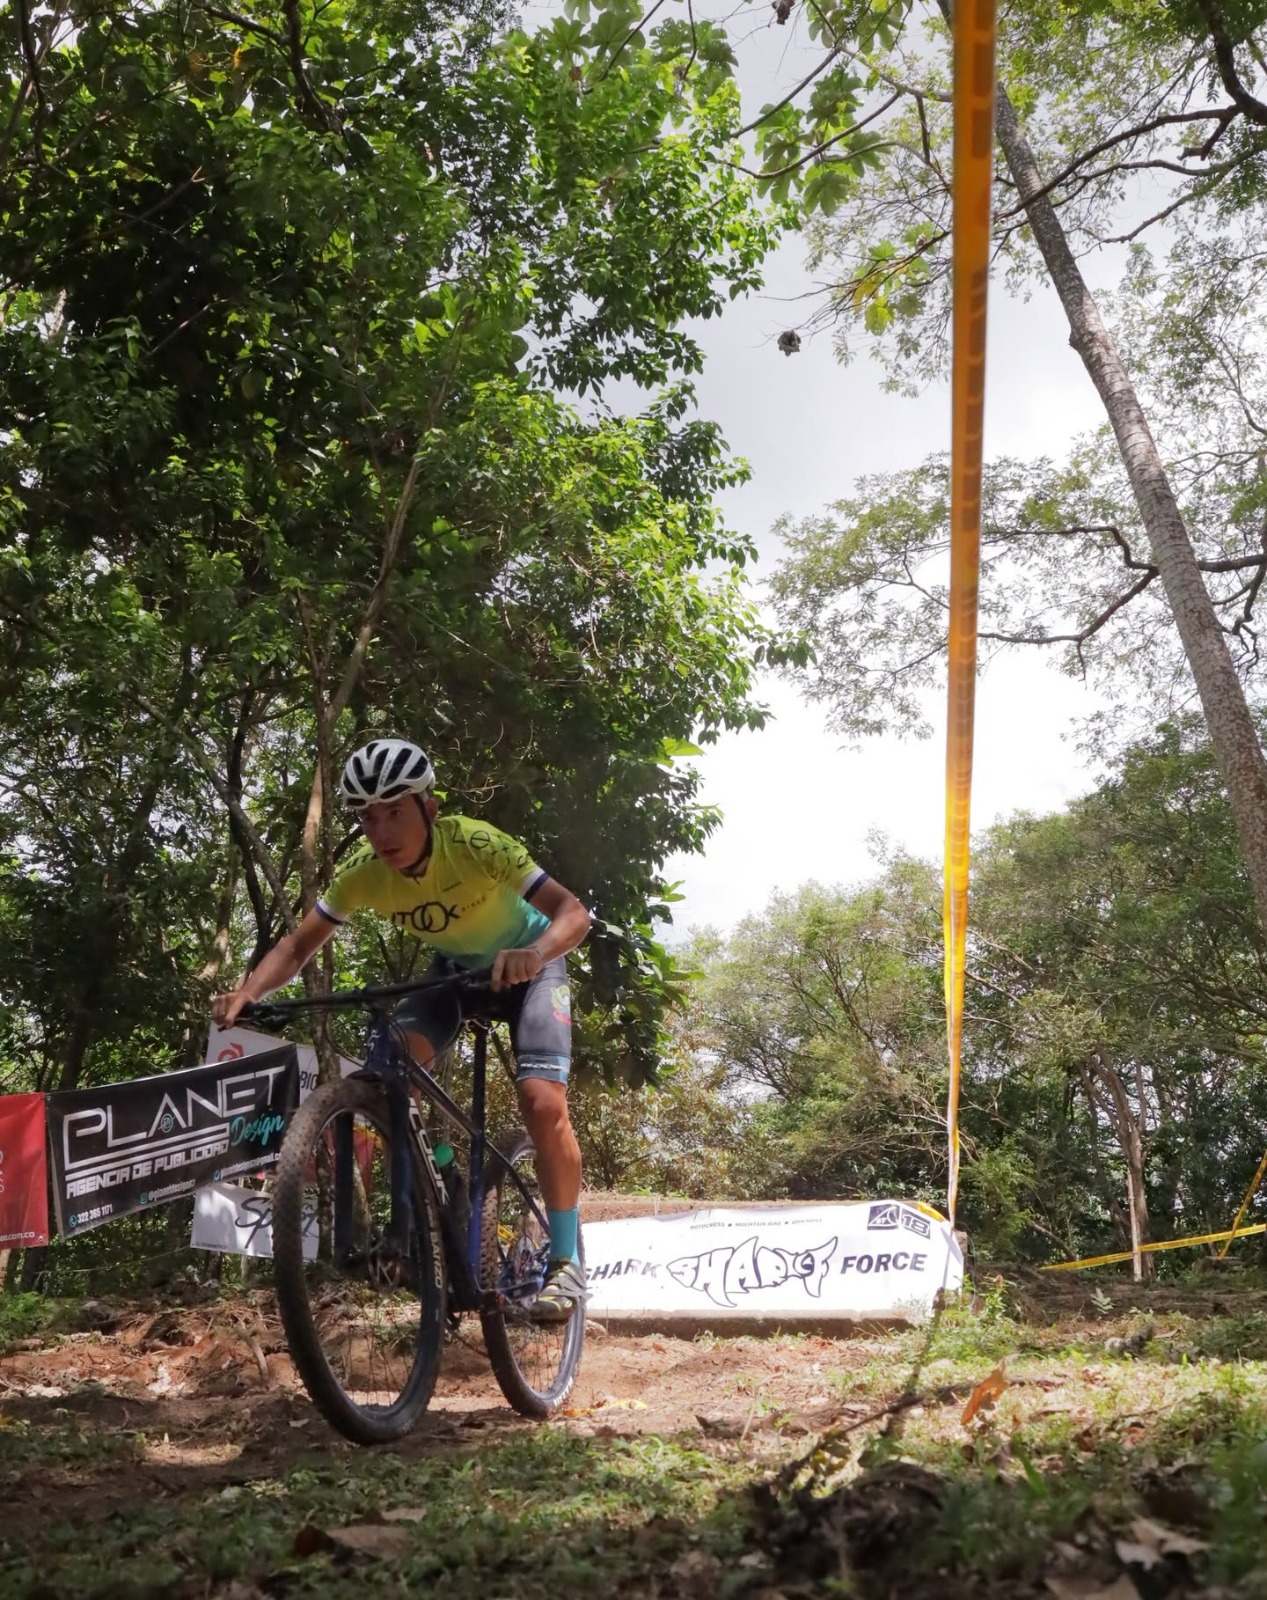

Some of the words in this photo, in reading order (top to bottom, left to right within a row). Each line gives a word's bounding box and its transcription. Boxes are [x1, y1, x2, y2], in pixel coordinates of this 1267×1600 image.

[63, 1065, 286, 1170] PLANET
[230, 1112, 285, 1147] Design
[66, 1166, 130, 1199] AGENCIA
[132, 1161, 152, 1180] DE
[153, 1139, 230, 1173] PUBLICIDAD
[902, 1214, 930, 1236] 18
[840, 1252, 928, 1275] FORCE
